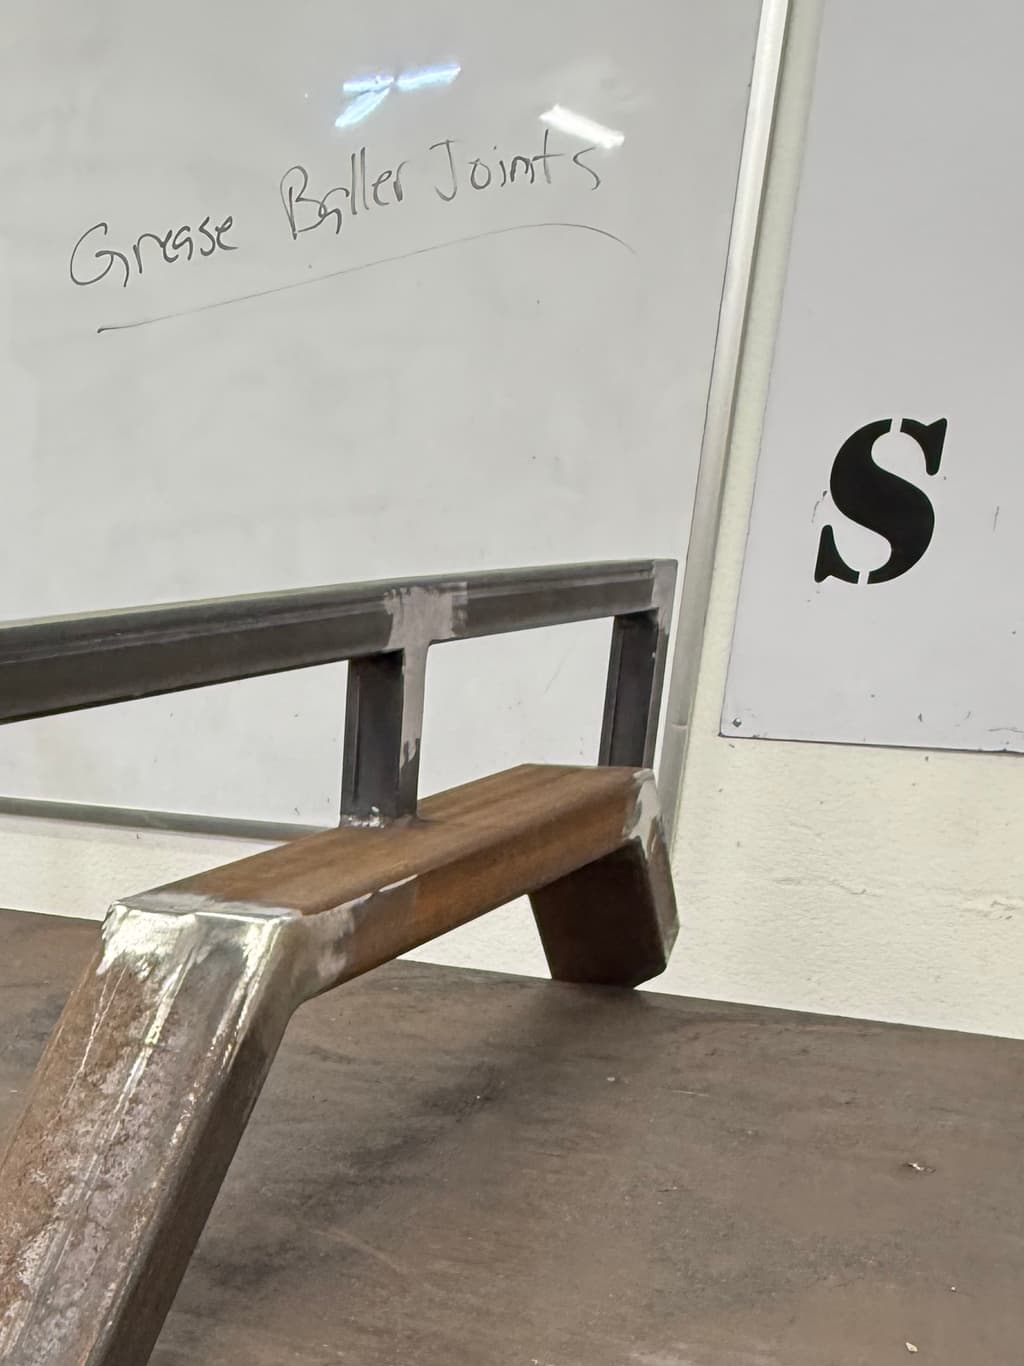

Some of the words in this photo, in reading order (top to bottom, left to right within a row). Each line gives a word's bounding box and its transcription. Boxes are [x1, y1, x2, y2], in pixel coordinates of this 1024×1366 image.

[69, 215, 240, 288] Grease
[428, 128, 602, 201] Joints
[814, 417, 948, 585] S
